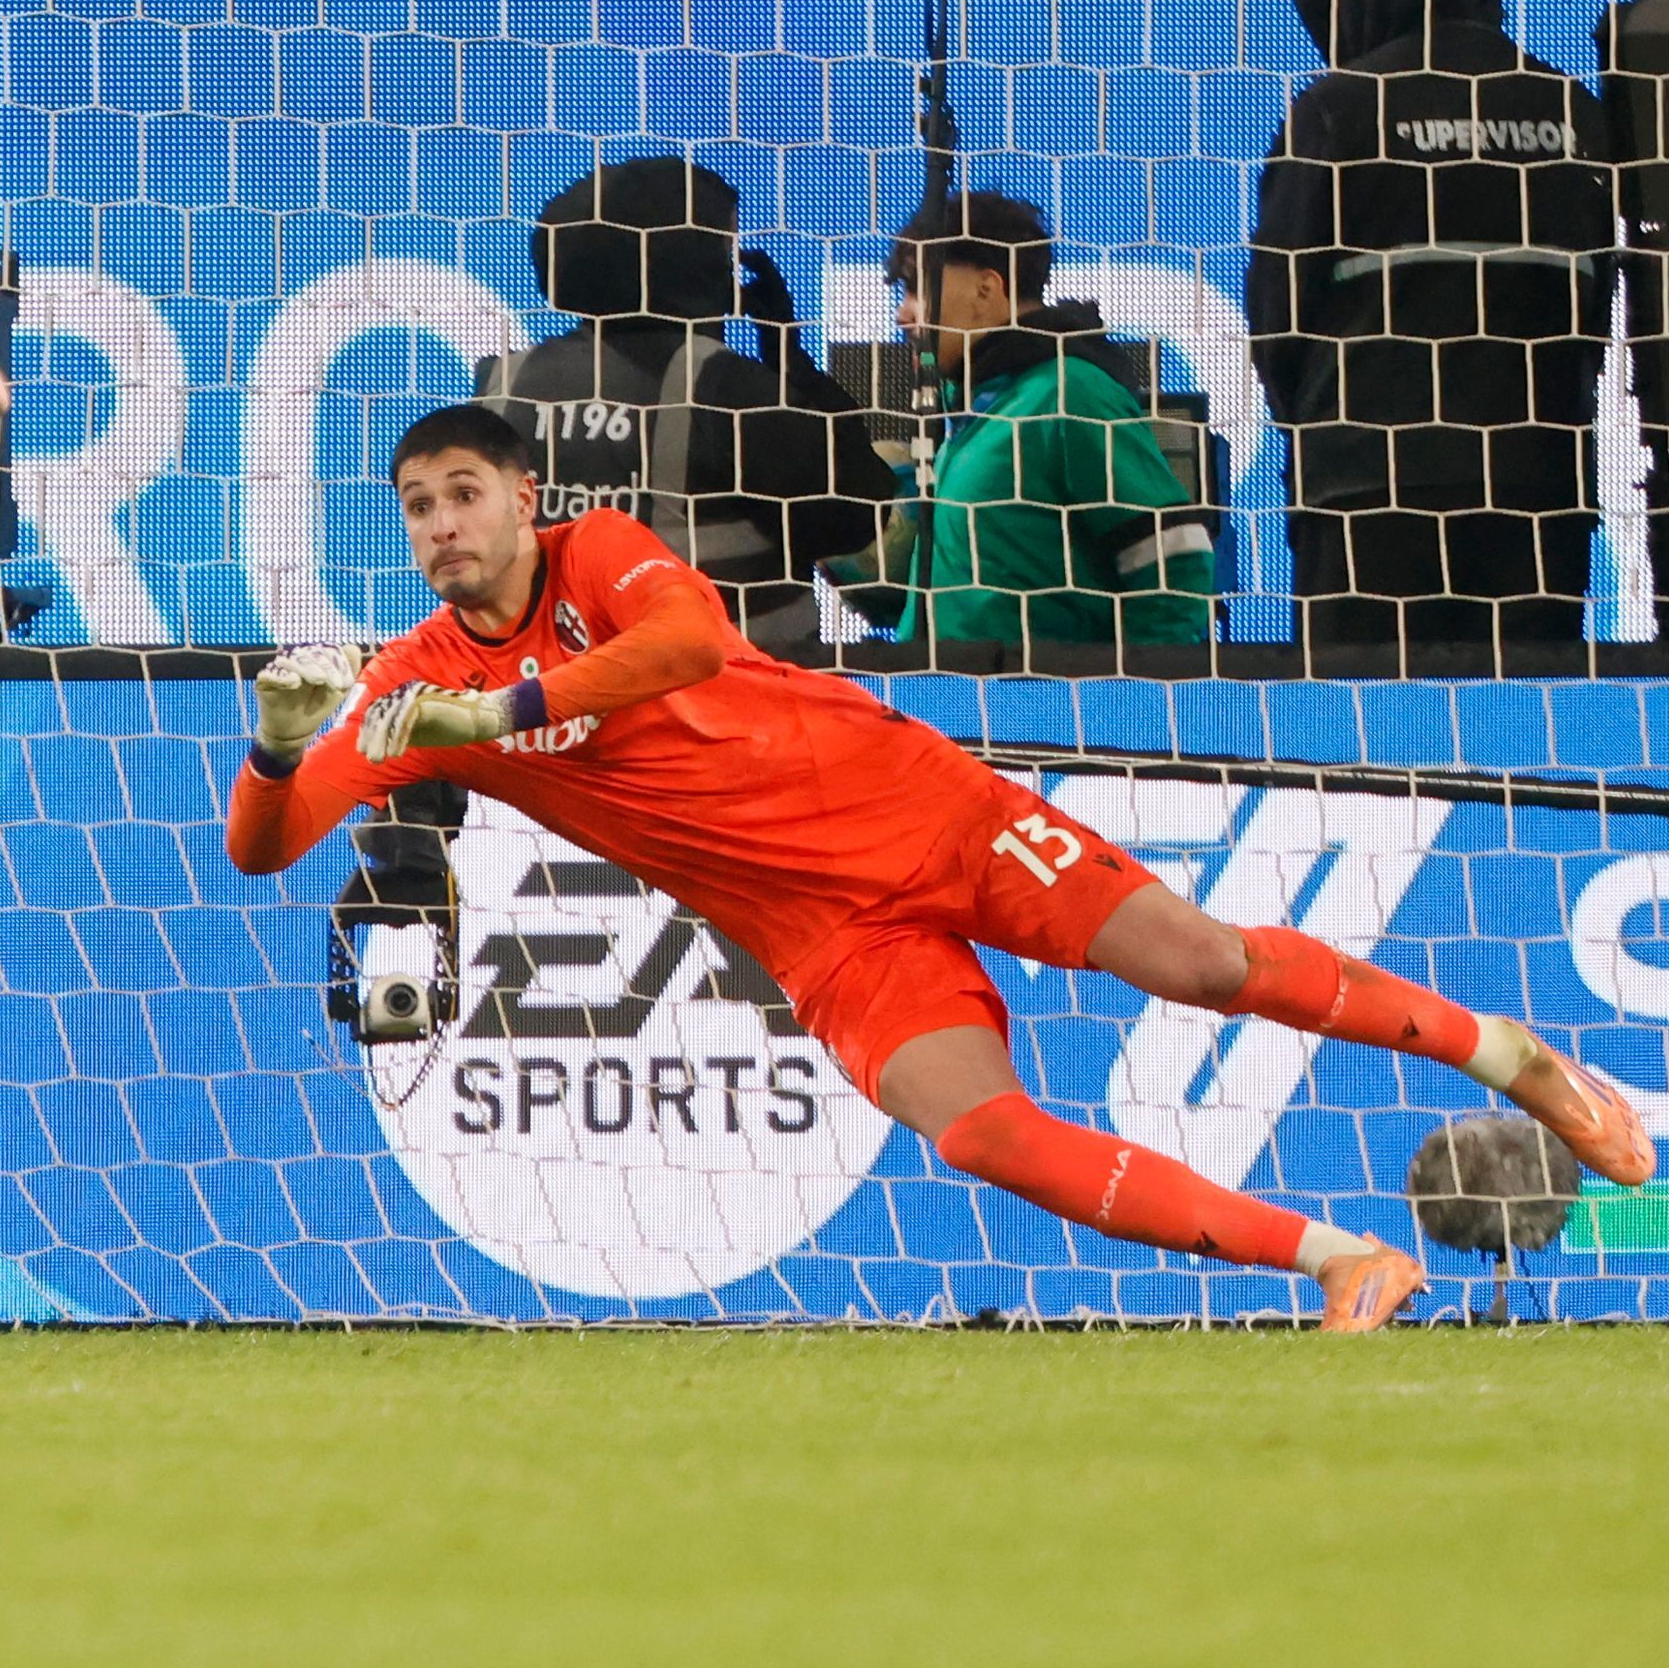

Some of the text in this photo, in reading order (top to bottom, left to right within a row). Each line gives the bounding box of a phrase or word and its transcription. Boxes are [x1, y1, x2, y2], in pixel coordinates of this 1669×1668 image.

[534, 402, 632, 442] 1196
[527, 469, 639, 520] uard
[991, 813, 1083, 888] 13
[453, 1057, 817, 1135] SPORTS
